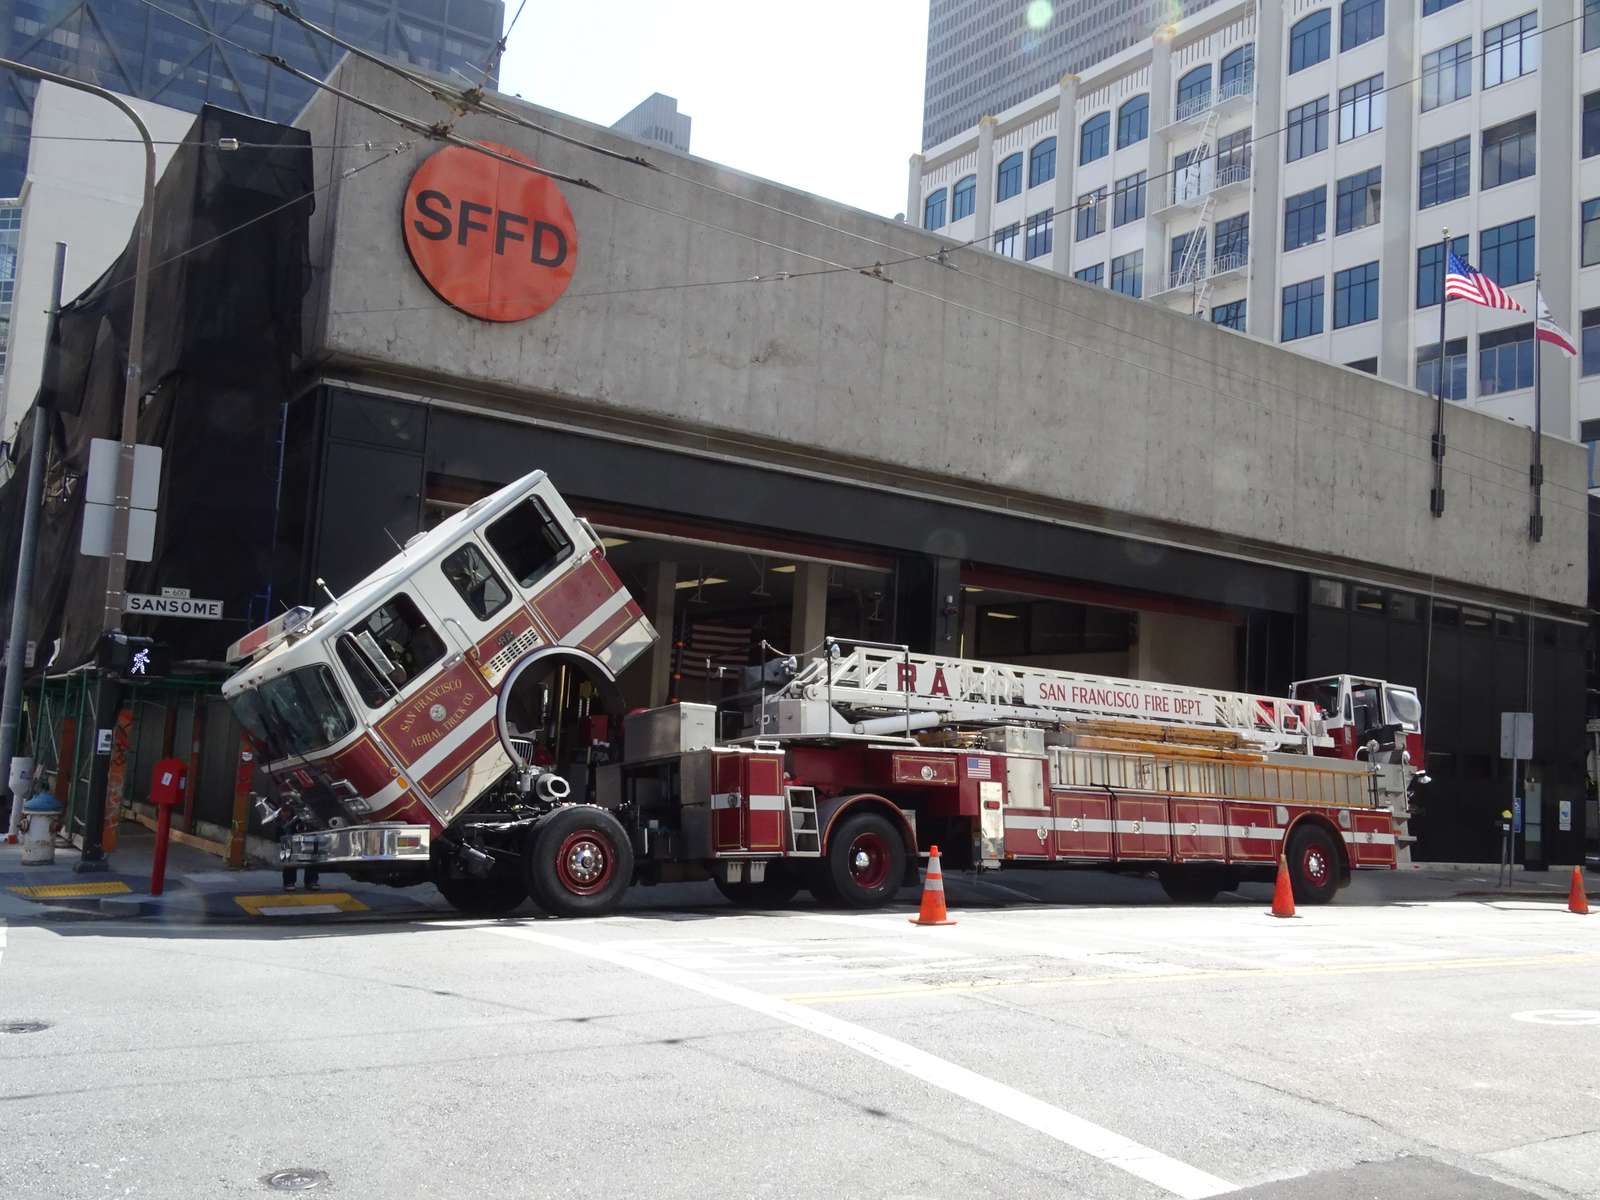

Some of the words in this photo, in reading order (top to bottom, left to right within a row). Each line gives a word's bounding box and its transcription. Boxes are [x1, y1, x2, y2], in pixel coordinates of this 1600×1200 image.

[414, 189, 568, 269] SFFD
[130, 597, 219, 616] SANSOME
[400, 711, 417, 733] SAN
[414, 679, 462, 713] FRANCISCO
[411, 728, 443, 748] AERIAL
[443, 708, 467, 730] TRUCK
[462, 693, 474, 706] CO
[1039, 682, 1066, 702] SAN
[1071, 686, 1139, 710] FRANCISCO
[1144, 694, 1169, 713] FIRE
[1174, 697, 1204, 717] DEPT.
